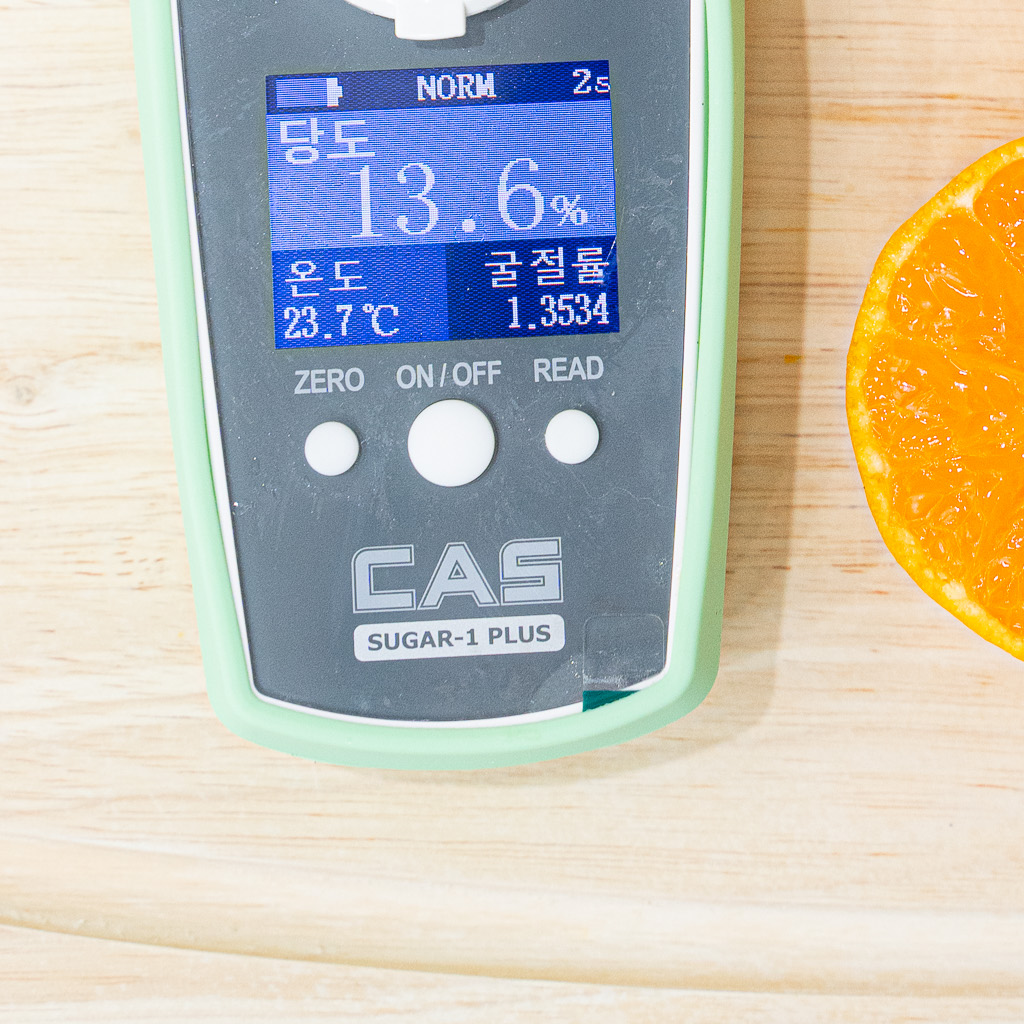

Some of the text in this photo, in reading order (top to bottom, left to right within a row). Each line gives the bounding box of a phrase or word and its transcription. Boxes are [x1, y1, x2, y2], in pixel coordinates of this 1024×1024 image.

[416, 68, 612, 102] NORM 2s
[279, 117, 376, 166] 당도
[284, 260, 368, 298] 온도
[484, 246, 610, 289] 굴절률
[508, 292, 611, 330] 1.3534
[294, 366, 365, 395] ZERO
[533, 355, 605, 382] READ
[350, 536, 565, 614] CAS
[367, 624, 552, 652] SUGAR-1 PLUS
